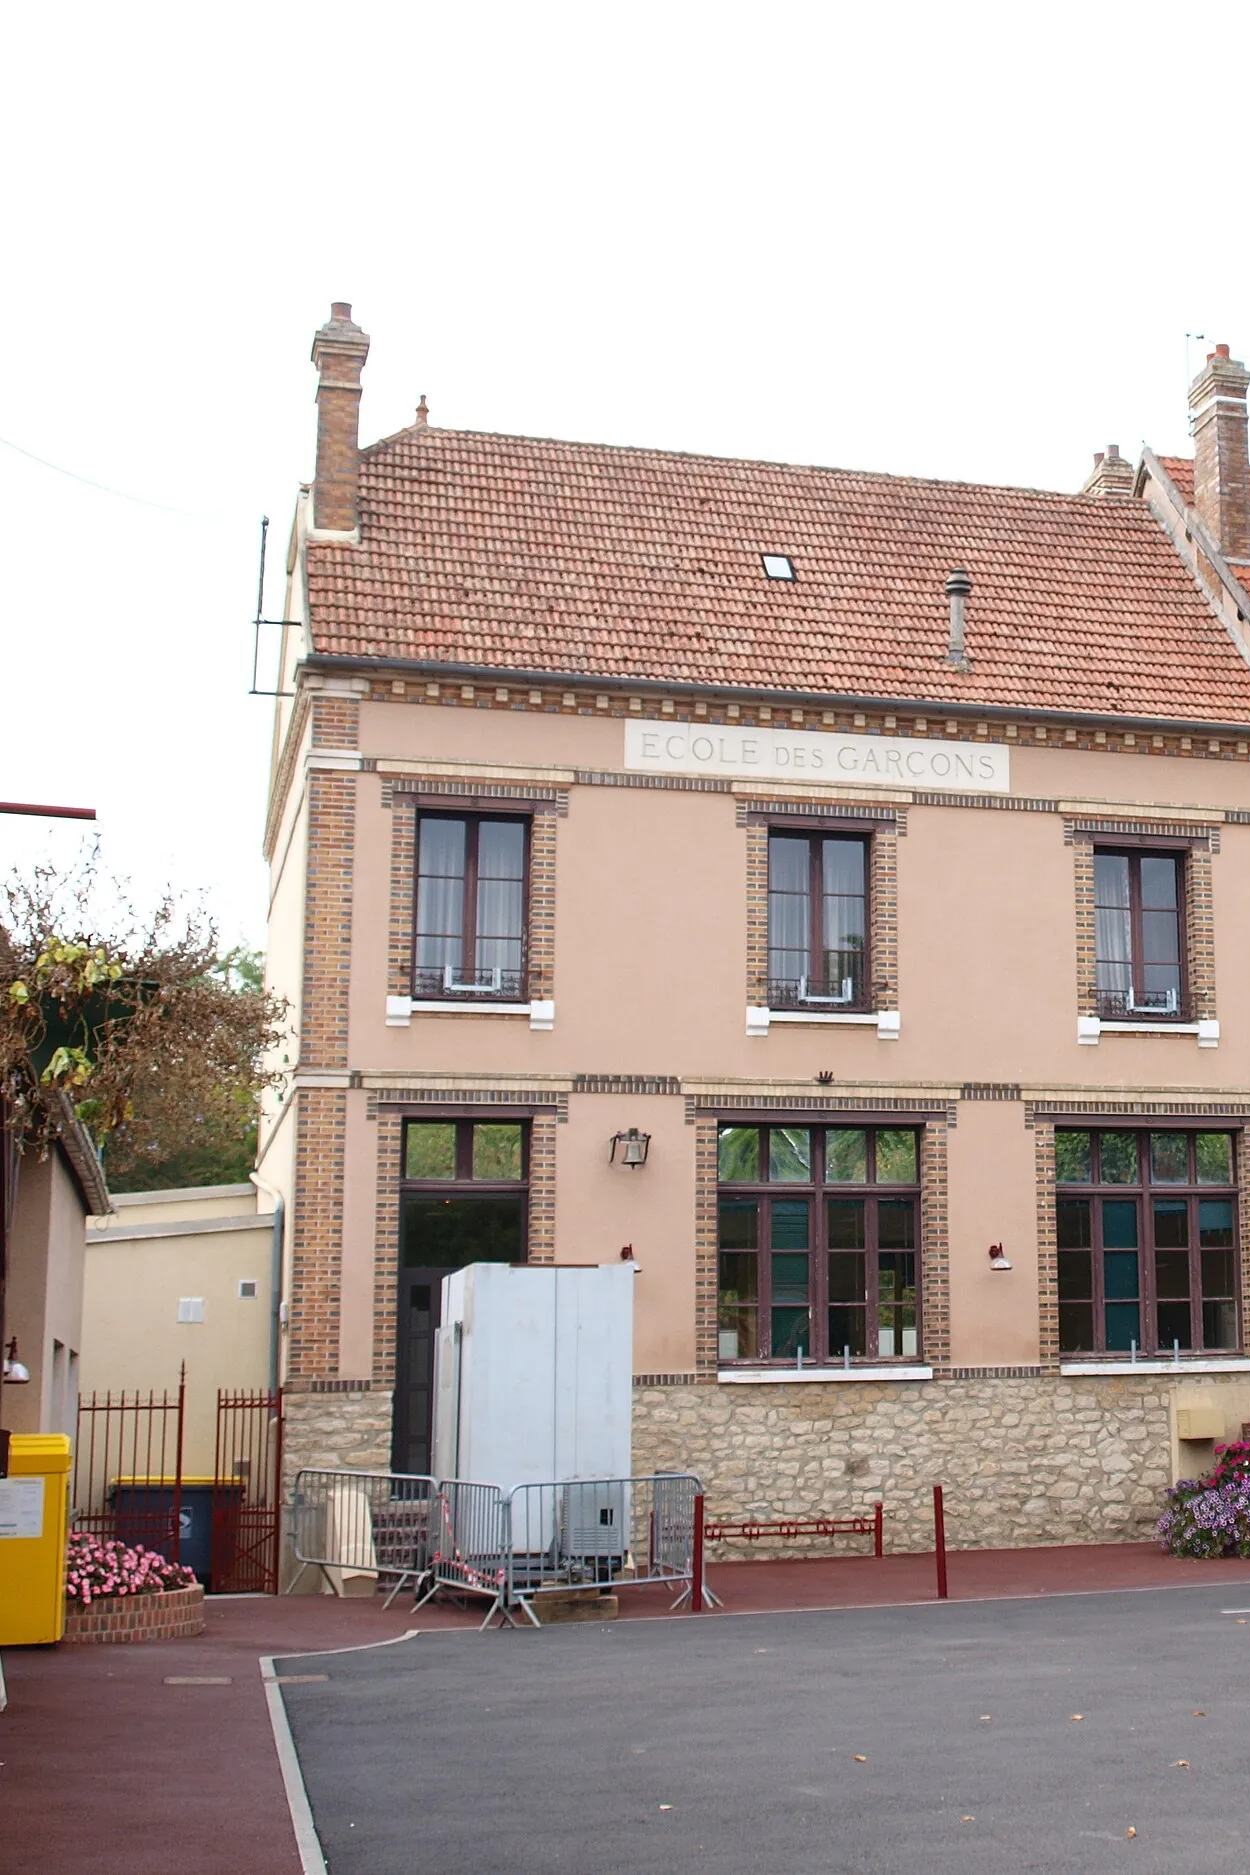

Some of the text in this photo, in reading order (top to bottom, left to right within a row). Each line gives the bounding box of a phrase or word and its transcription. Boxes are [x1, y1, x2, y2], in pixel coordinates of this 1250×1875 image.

[641, 733, 996, 780] ECOLE DES GARÇONS
